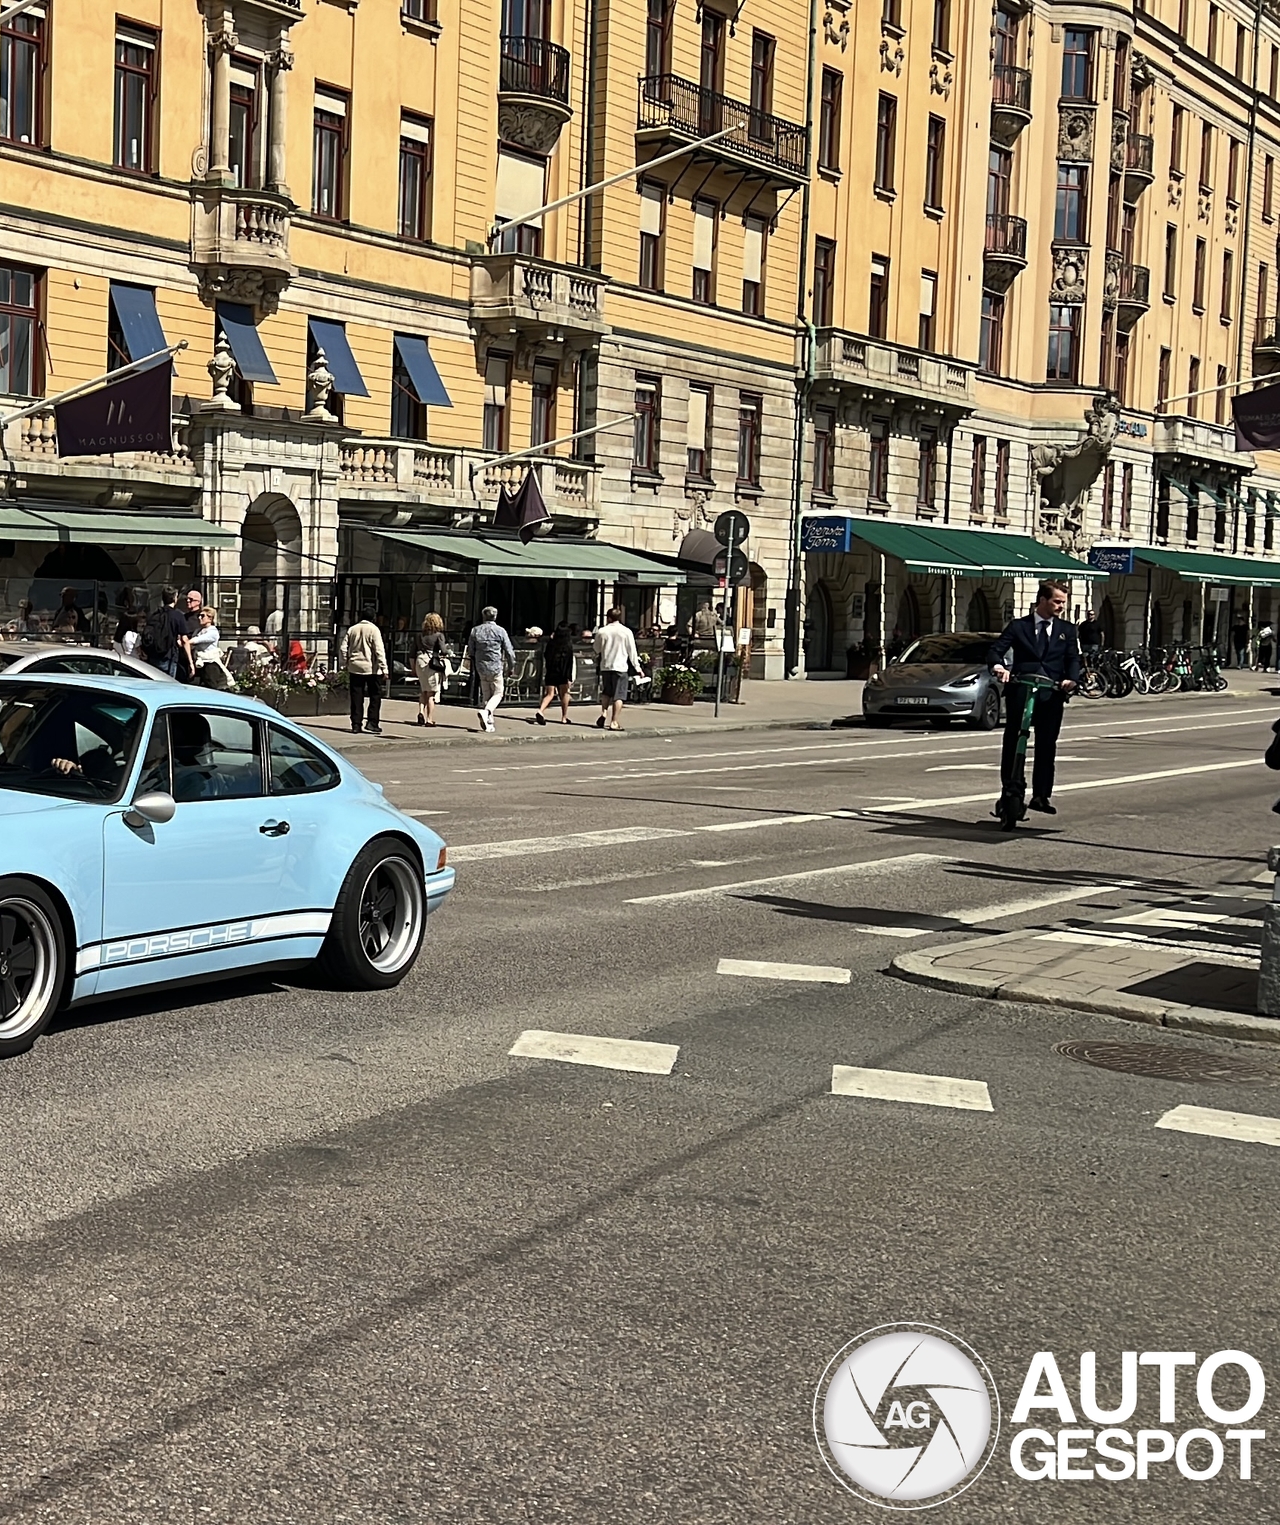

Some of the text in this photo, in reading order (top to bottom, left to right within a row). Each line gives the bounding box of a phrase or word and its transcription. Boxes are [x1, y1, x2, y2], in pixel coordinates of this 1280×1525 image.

[78, 432, 164, 446] MAGNUSSON
[805, 535, 838, 550] Tenn
[105, 922, 249, 962] PORSCHE
